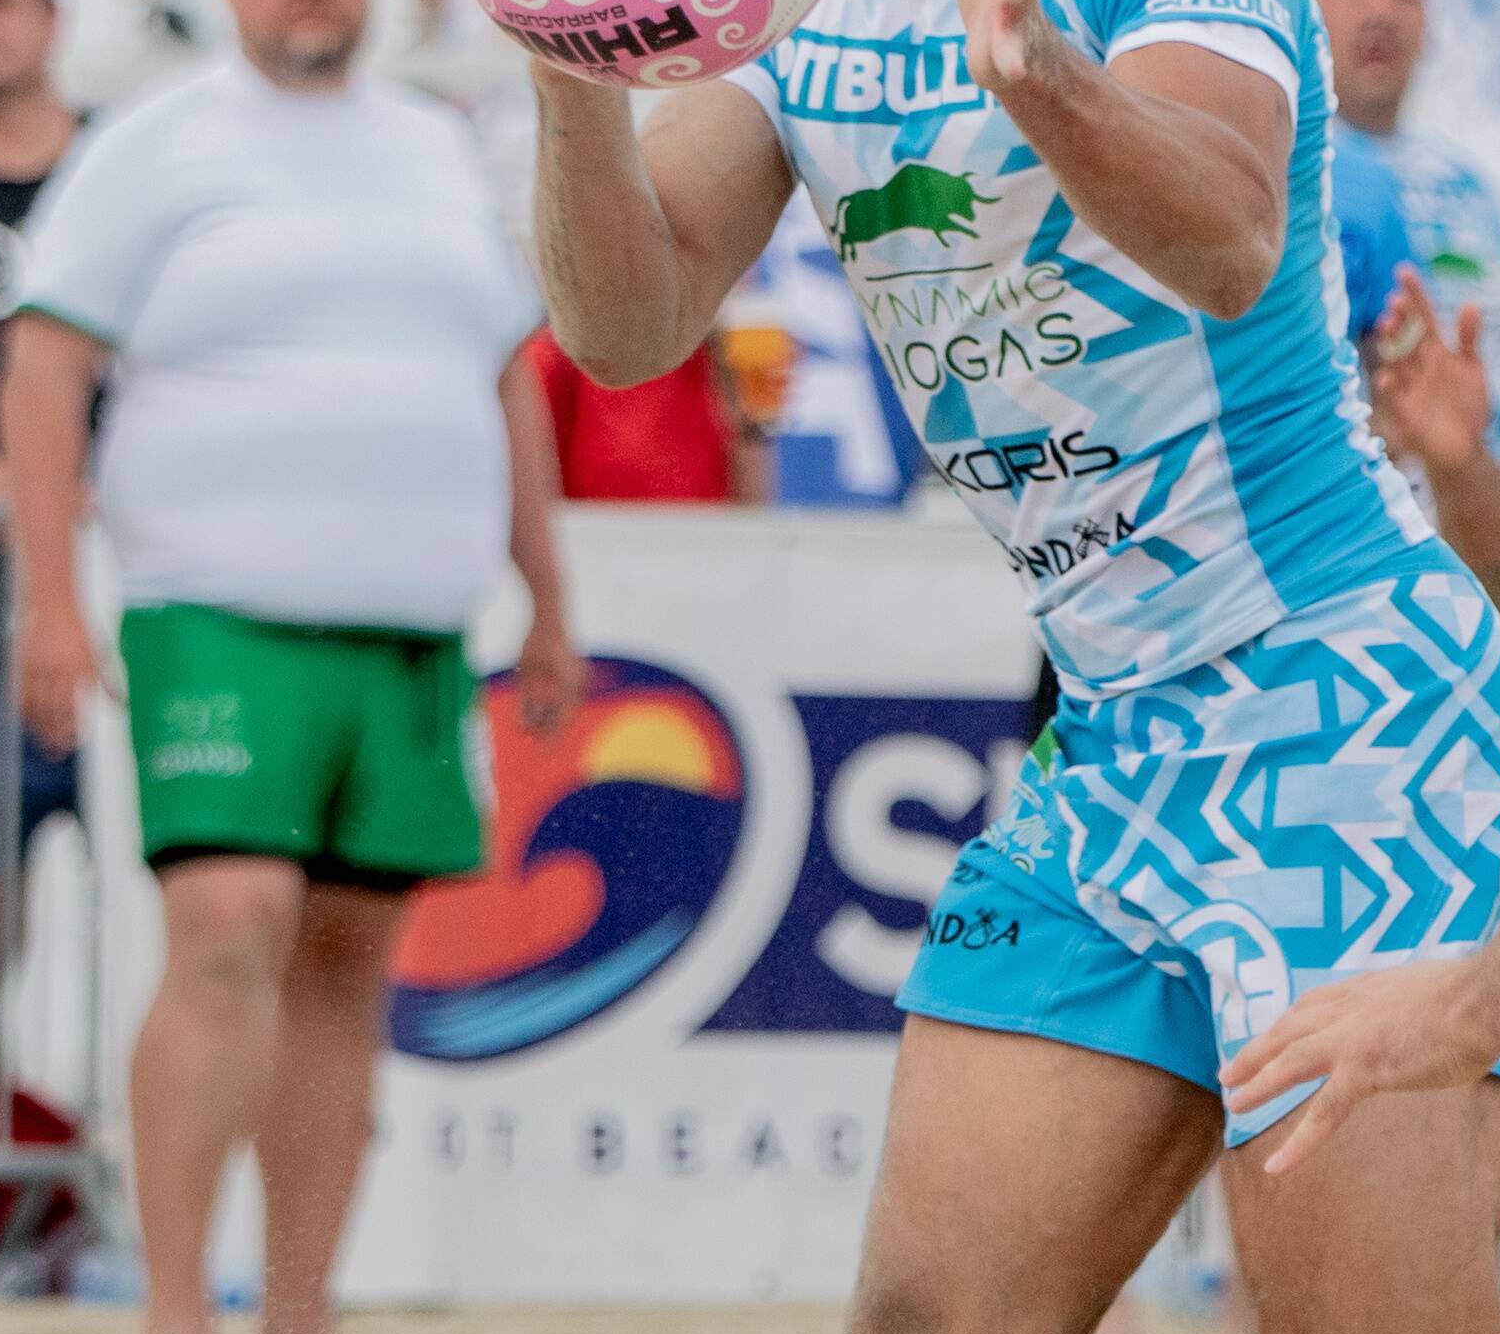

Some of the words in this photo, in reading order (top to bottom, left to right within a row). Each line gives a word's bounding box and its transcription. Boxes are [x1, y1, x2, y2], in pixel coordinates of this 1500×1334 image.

[502, 4, 628, 30] BARRACUDA
[856, 265, 1066, 329] YNAMIC
[884, 312, 1083, 391] IOGAS
[574, 1107, 868, 1177] BEAC
